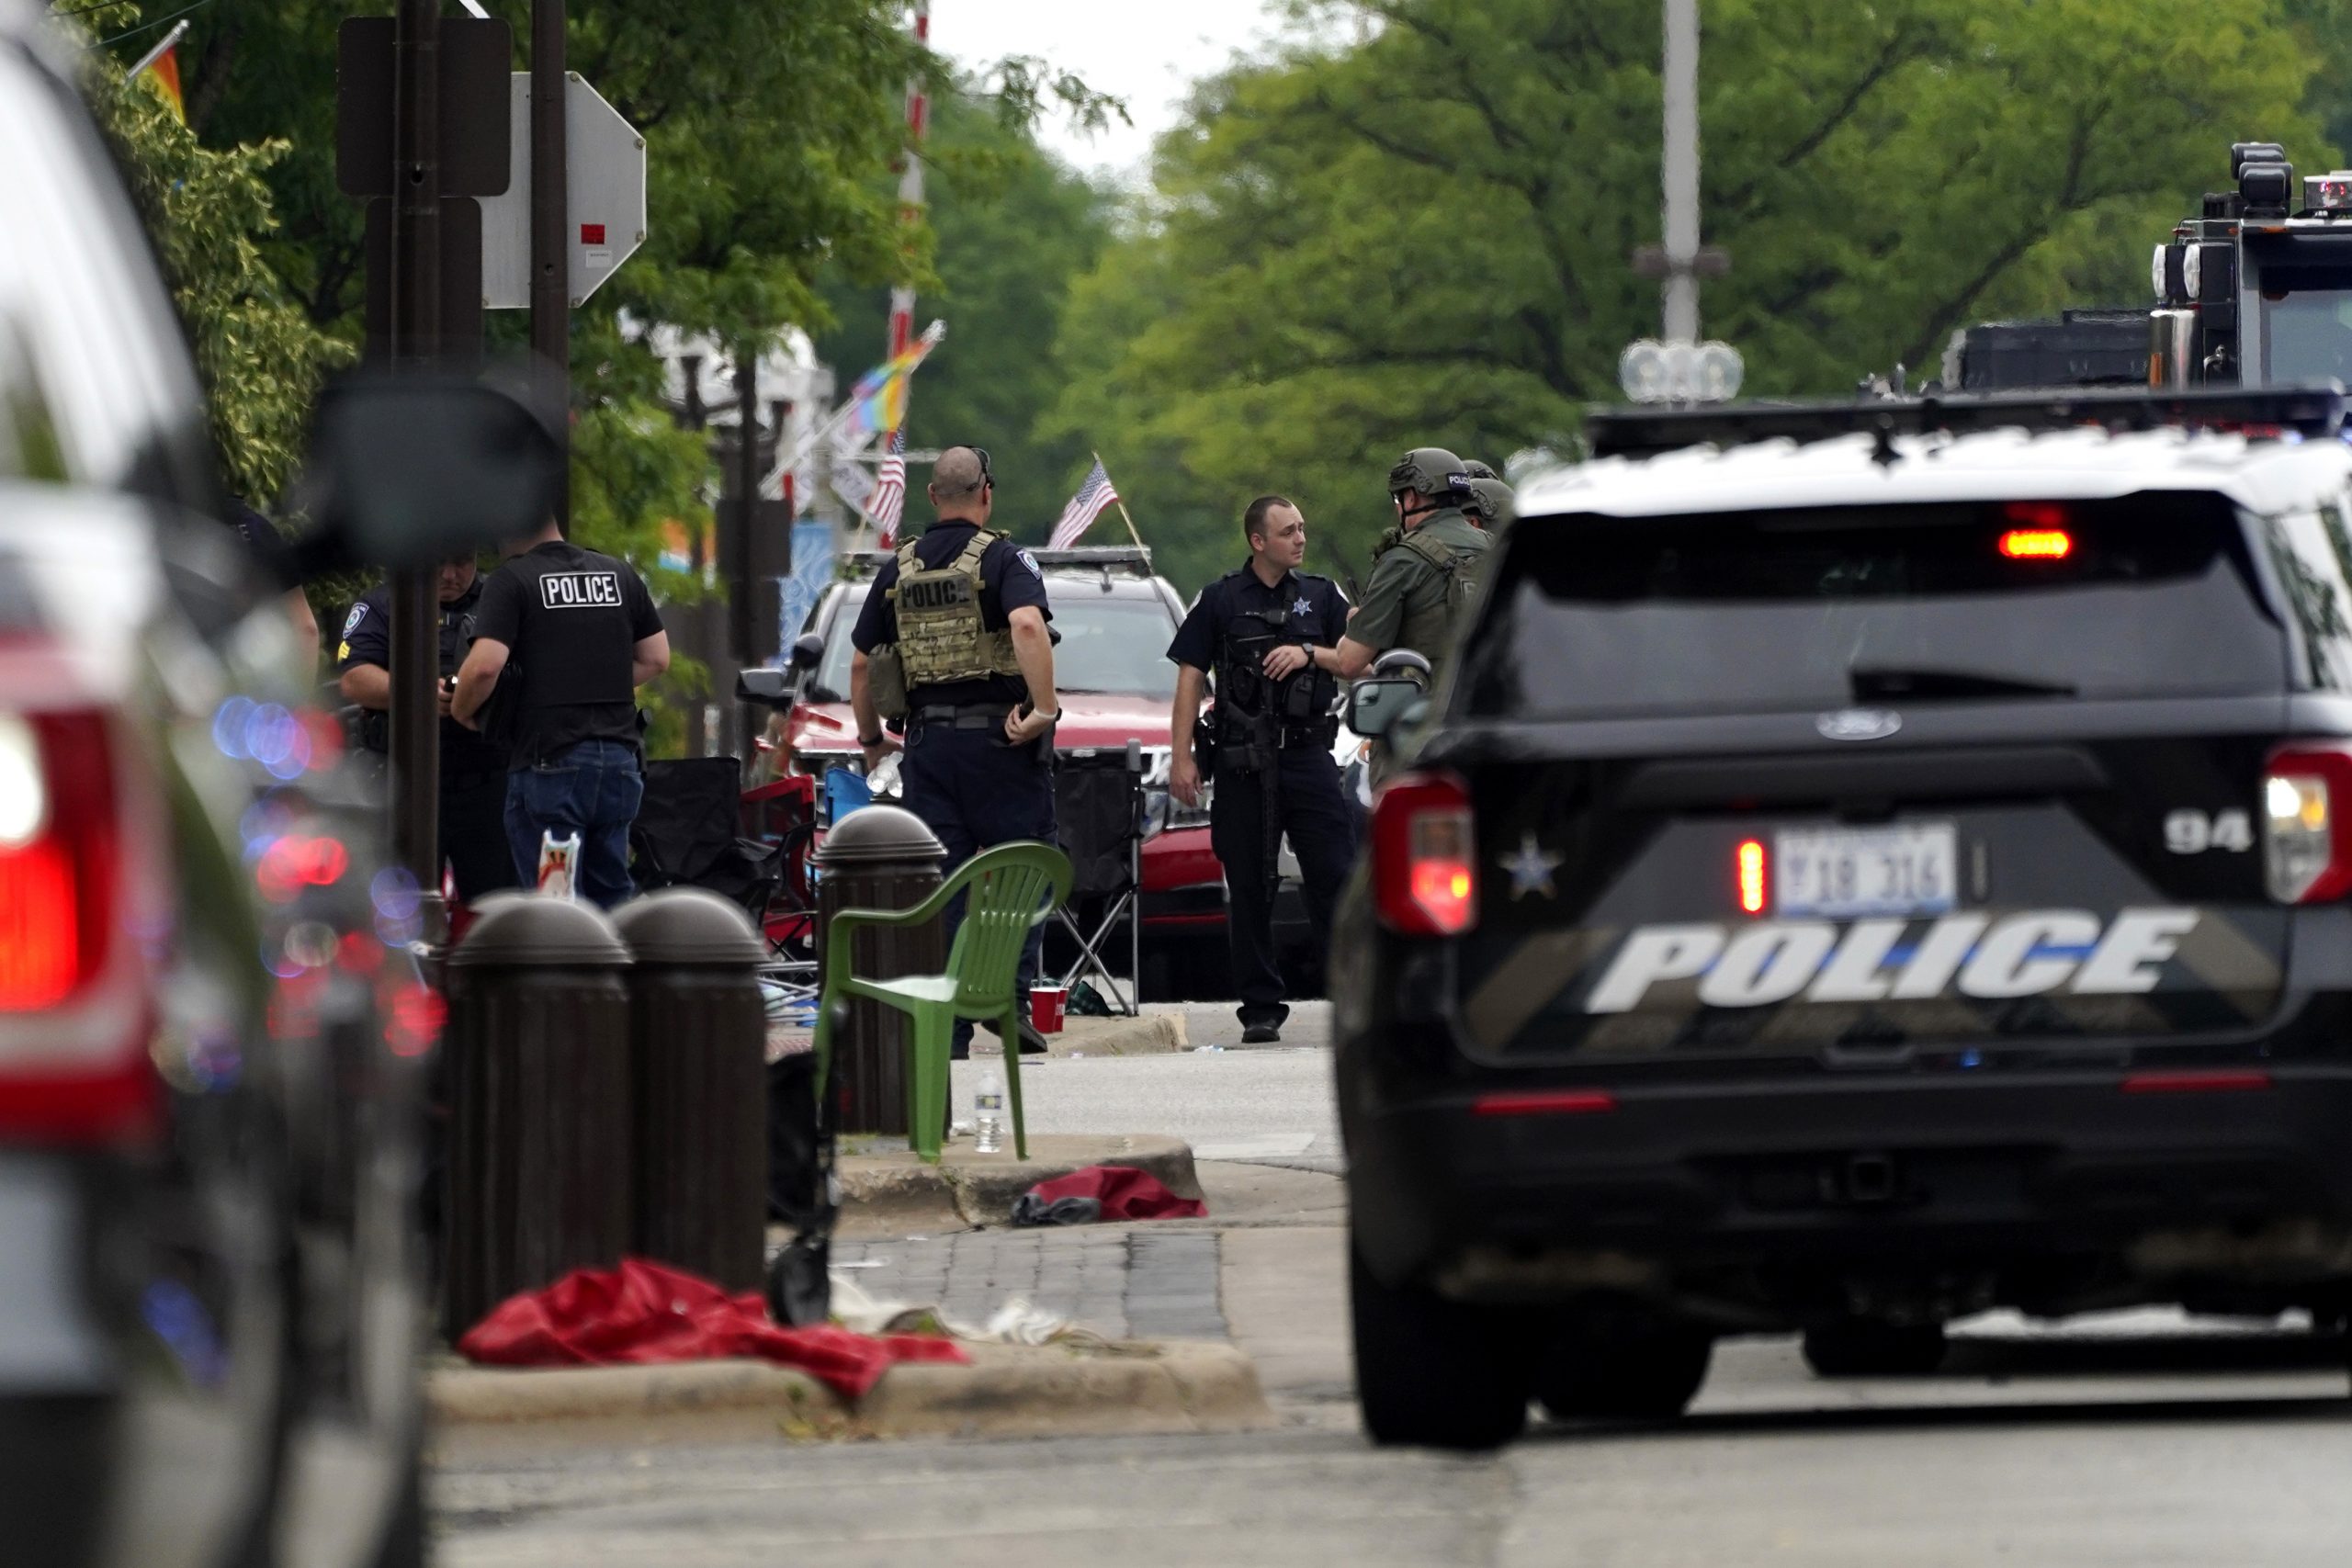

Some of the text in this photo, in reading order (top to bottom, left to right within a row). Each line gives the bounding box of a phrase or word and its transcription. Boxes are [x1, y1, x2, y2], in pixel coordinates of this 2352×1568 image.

[546, 576, 616, 604] POLICE
[2165, 808, 2255, 854] 94
[1585, 906, 2199, 1014] POLICE
